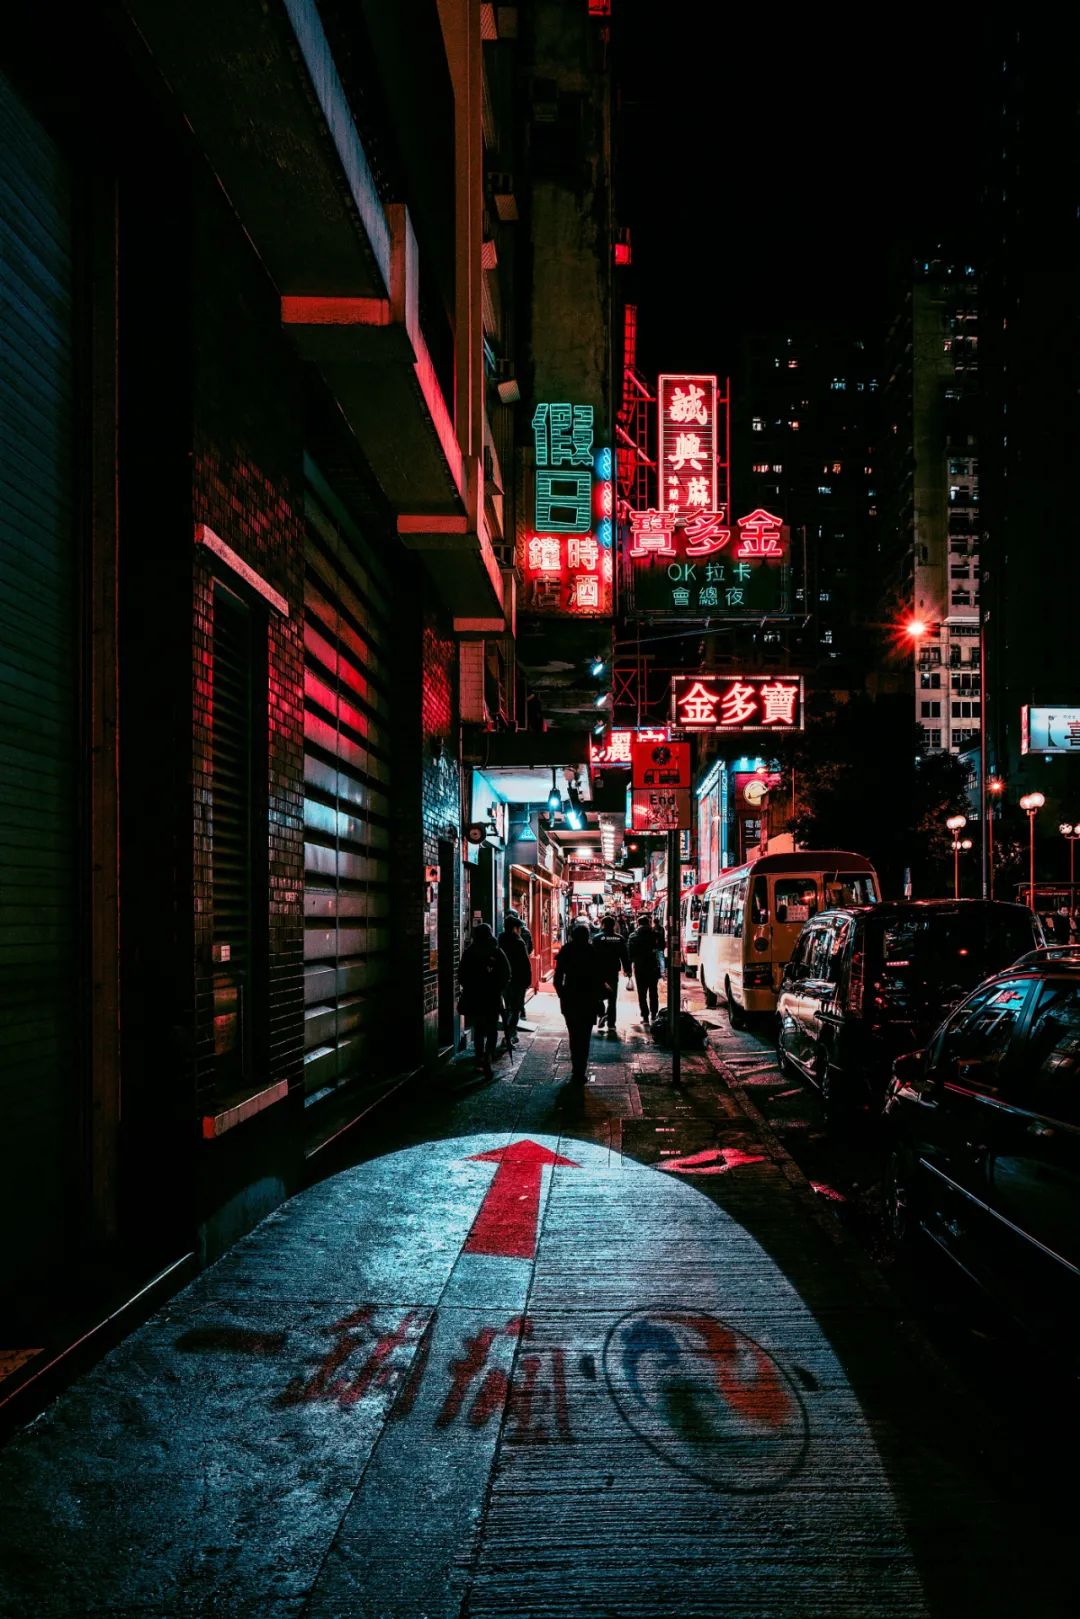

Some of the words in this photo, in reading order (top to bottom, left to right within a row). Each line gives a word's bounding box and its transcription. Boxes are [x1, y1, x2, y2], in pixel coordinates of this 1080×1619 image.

[531, 402, 594, 533] 假日
[678, 682, 798, 724] 金多寶
[649, 794, 676, 805] End
